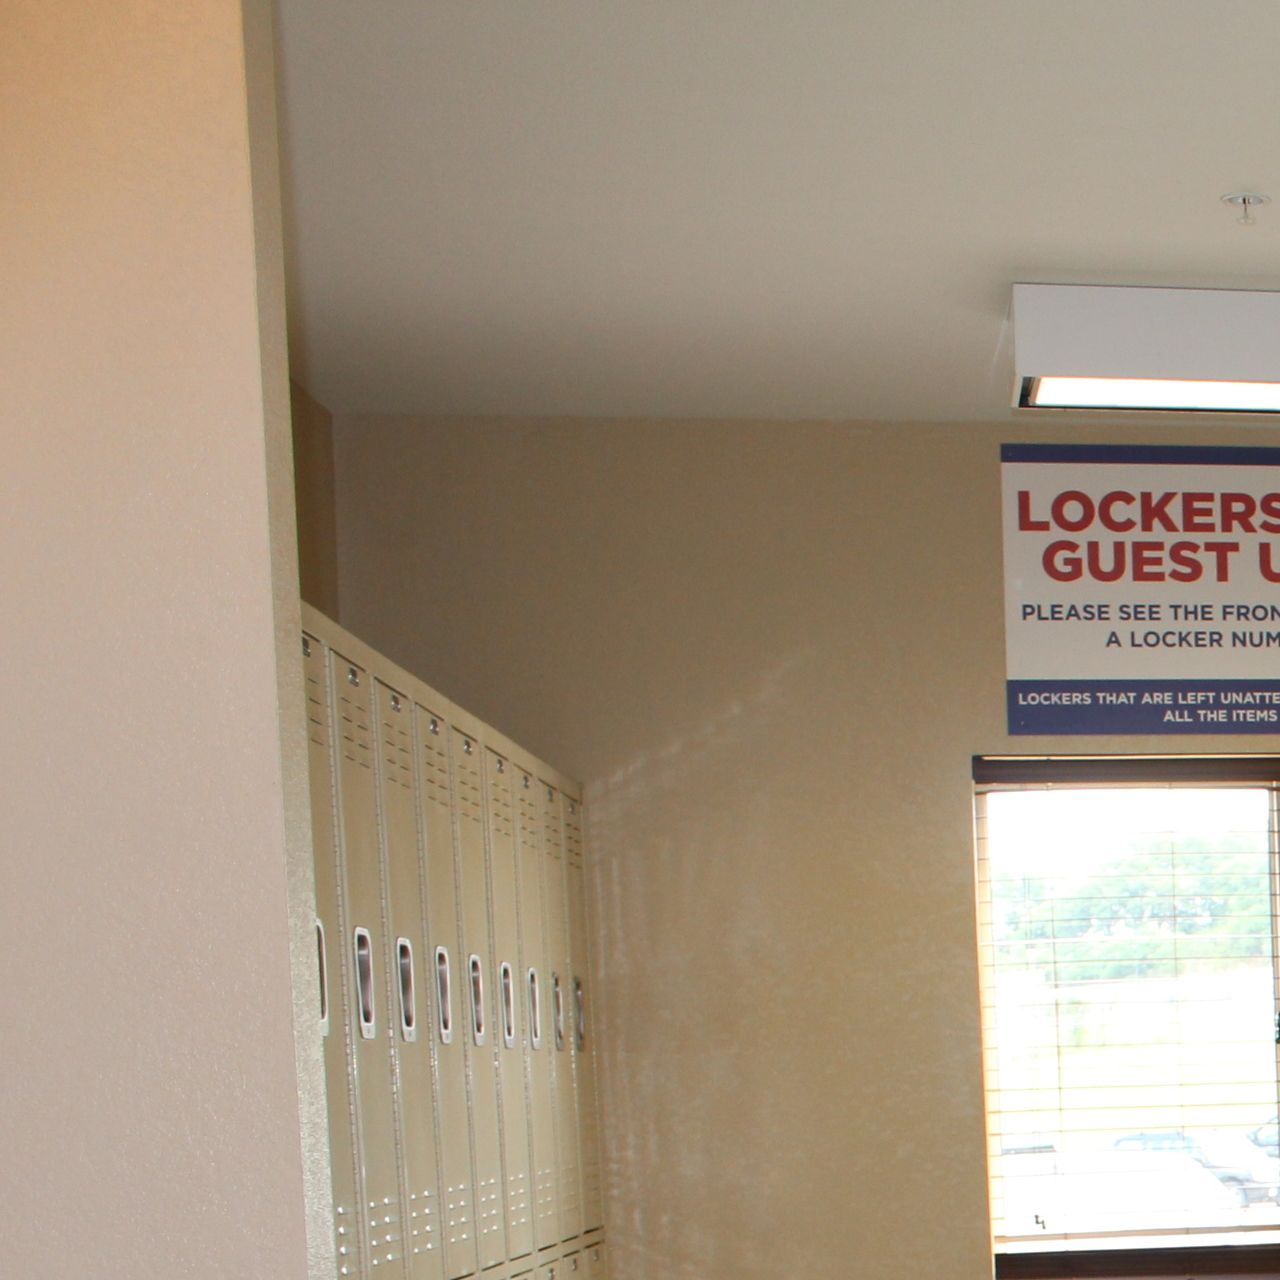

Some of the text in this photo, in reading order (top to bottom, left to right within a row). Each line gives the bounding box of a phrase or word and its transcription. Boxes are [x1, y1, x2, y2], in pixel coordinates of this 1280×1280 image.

[1042, 541, 1241, 583] GUEST
[1021, 603, 1111, 621] PLEASE
[1118, 604, 1162, 621] SEE
[1168, 604, 1214, 622] THE
[1105, 630, 1122, 648] A
[1130, 630, 1223, 648] LOCKER
[1018, 692, 1092, 705] LOCKERS
[1096, 692, 1137, 705] THAT
[1141, 692, 1174, 705] ARE
[1178, 692, 1216, 705] LEFT
[1163, 709, 1193, 722] ALL
[1197, 709, 1228, 722] THE
[1232, 709, 1278, 722] ITEMS
